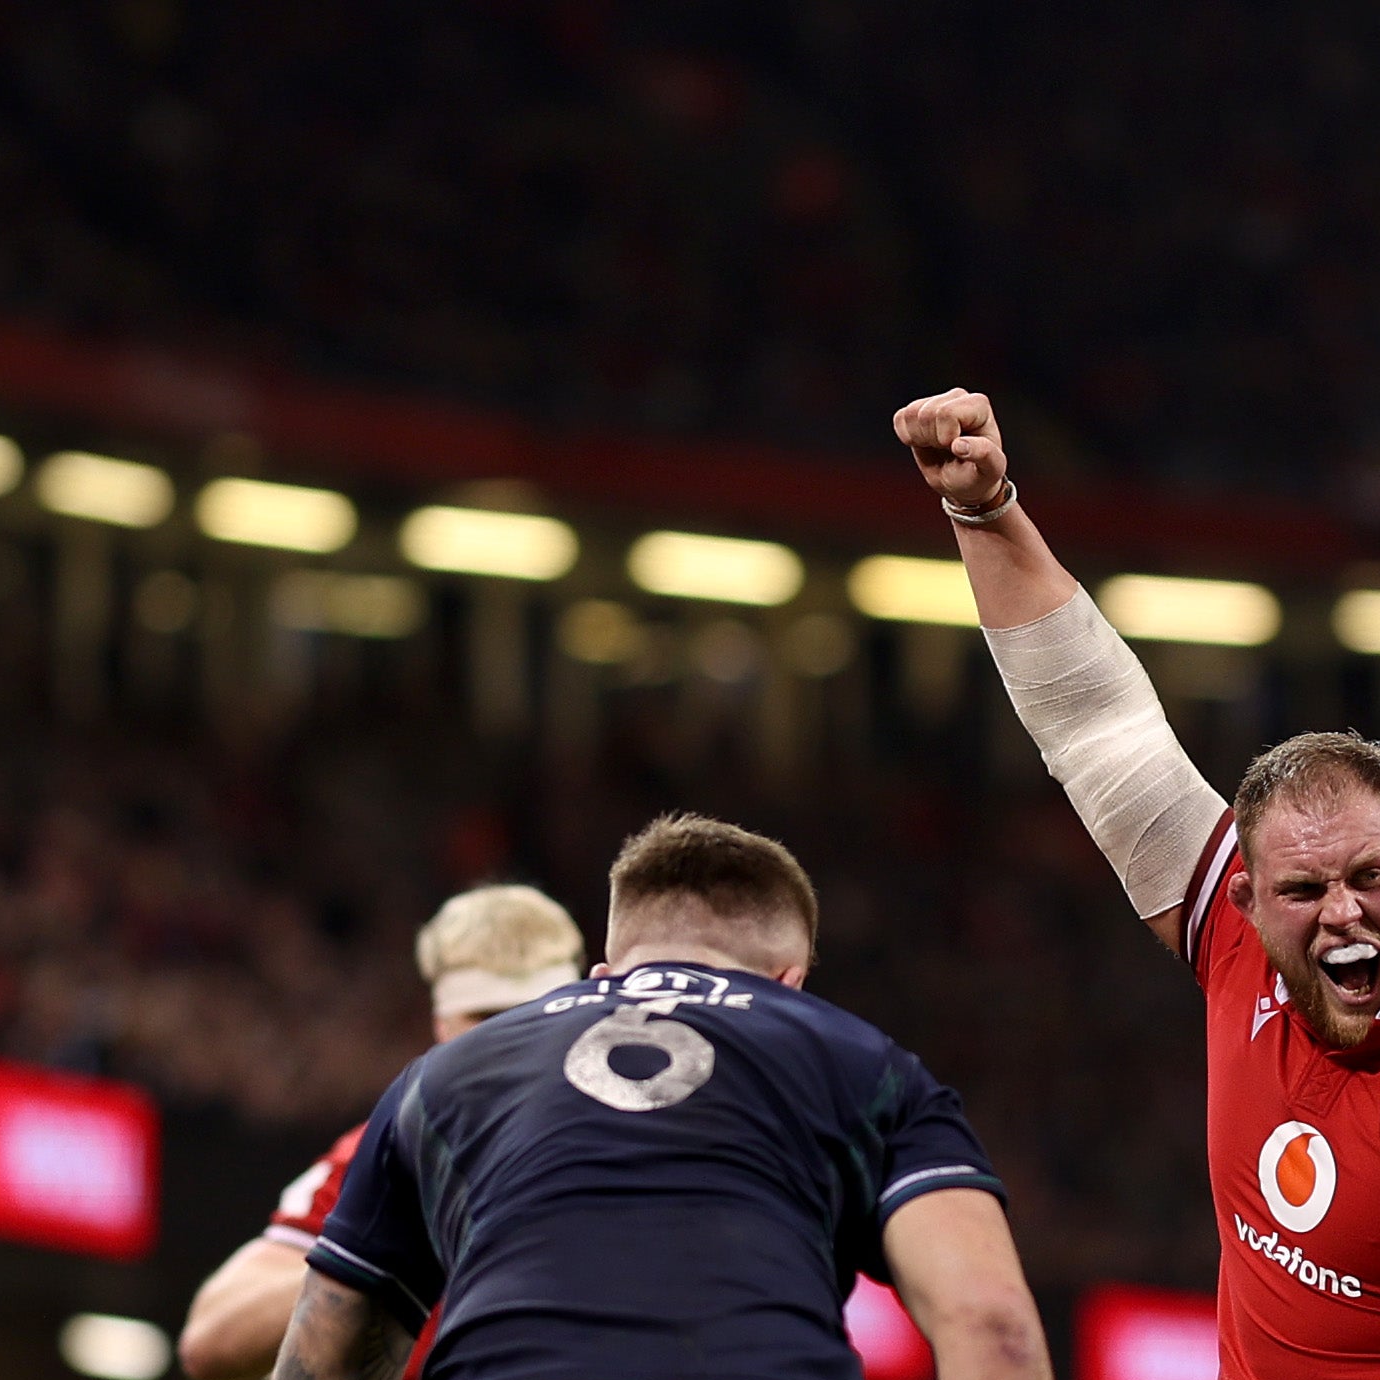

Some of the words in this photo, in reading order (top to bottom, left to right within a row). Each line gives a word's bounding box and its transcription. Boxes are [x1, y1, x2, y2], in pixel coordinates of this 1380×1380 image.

[626, 970, 699, 991] BT
[563, 1000, 716, 1113] 6
[1233, 1212, 1362, 1298] vodafone
